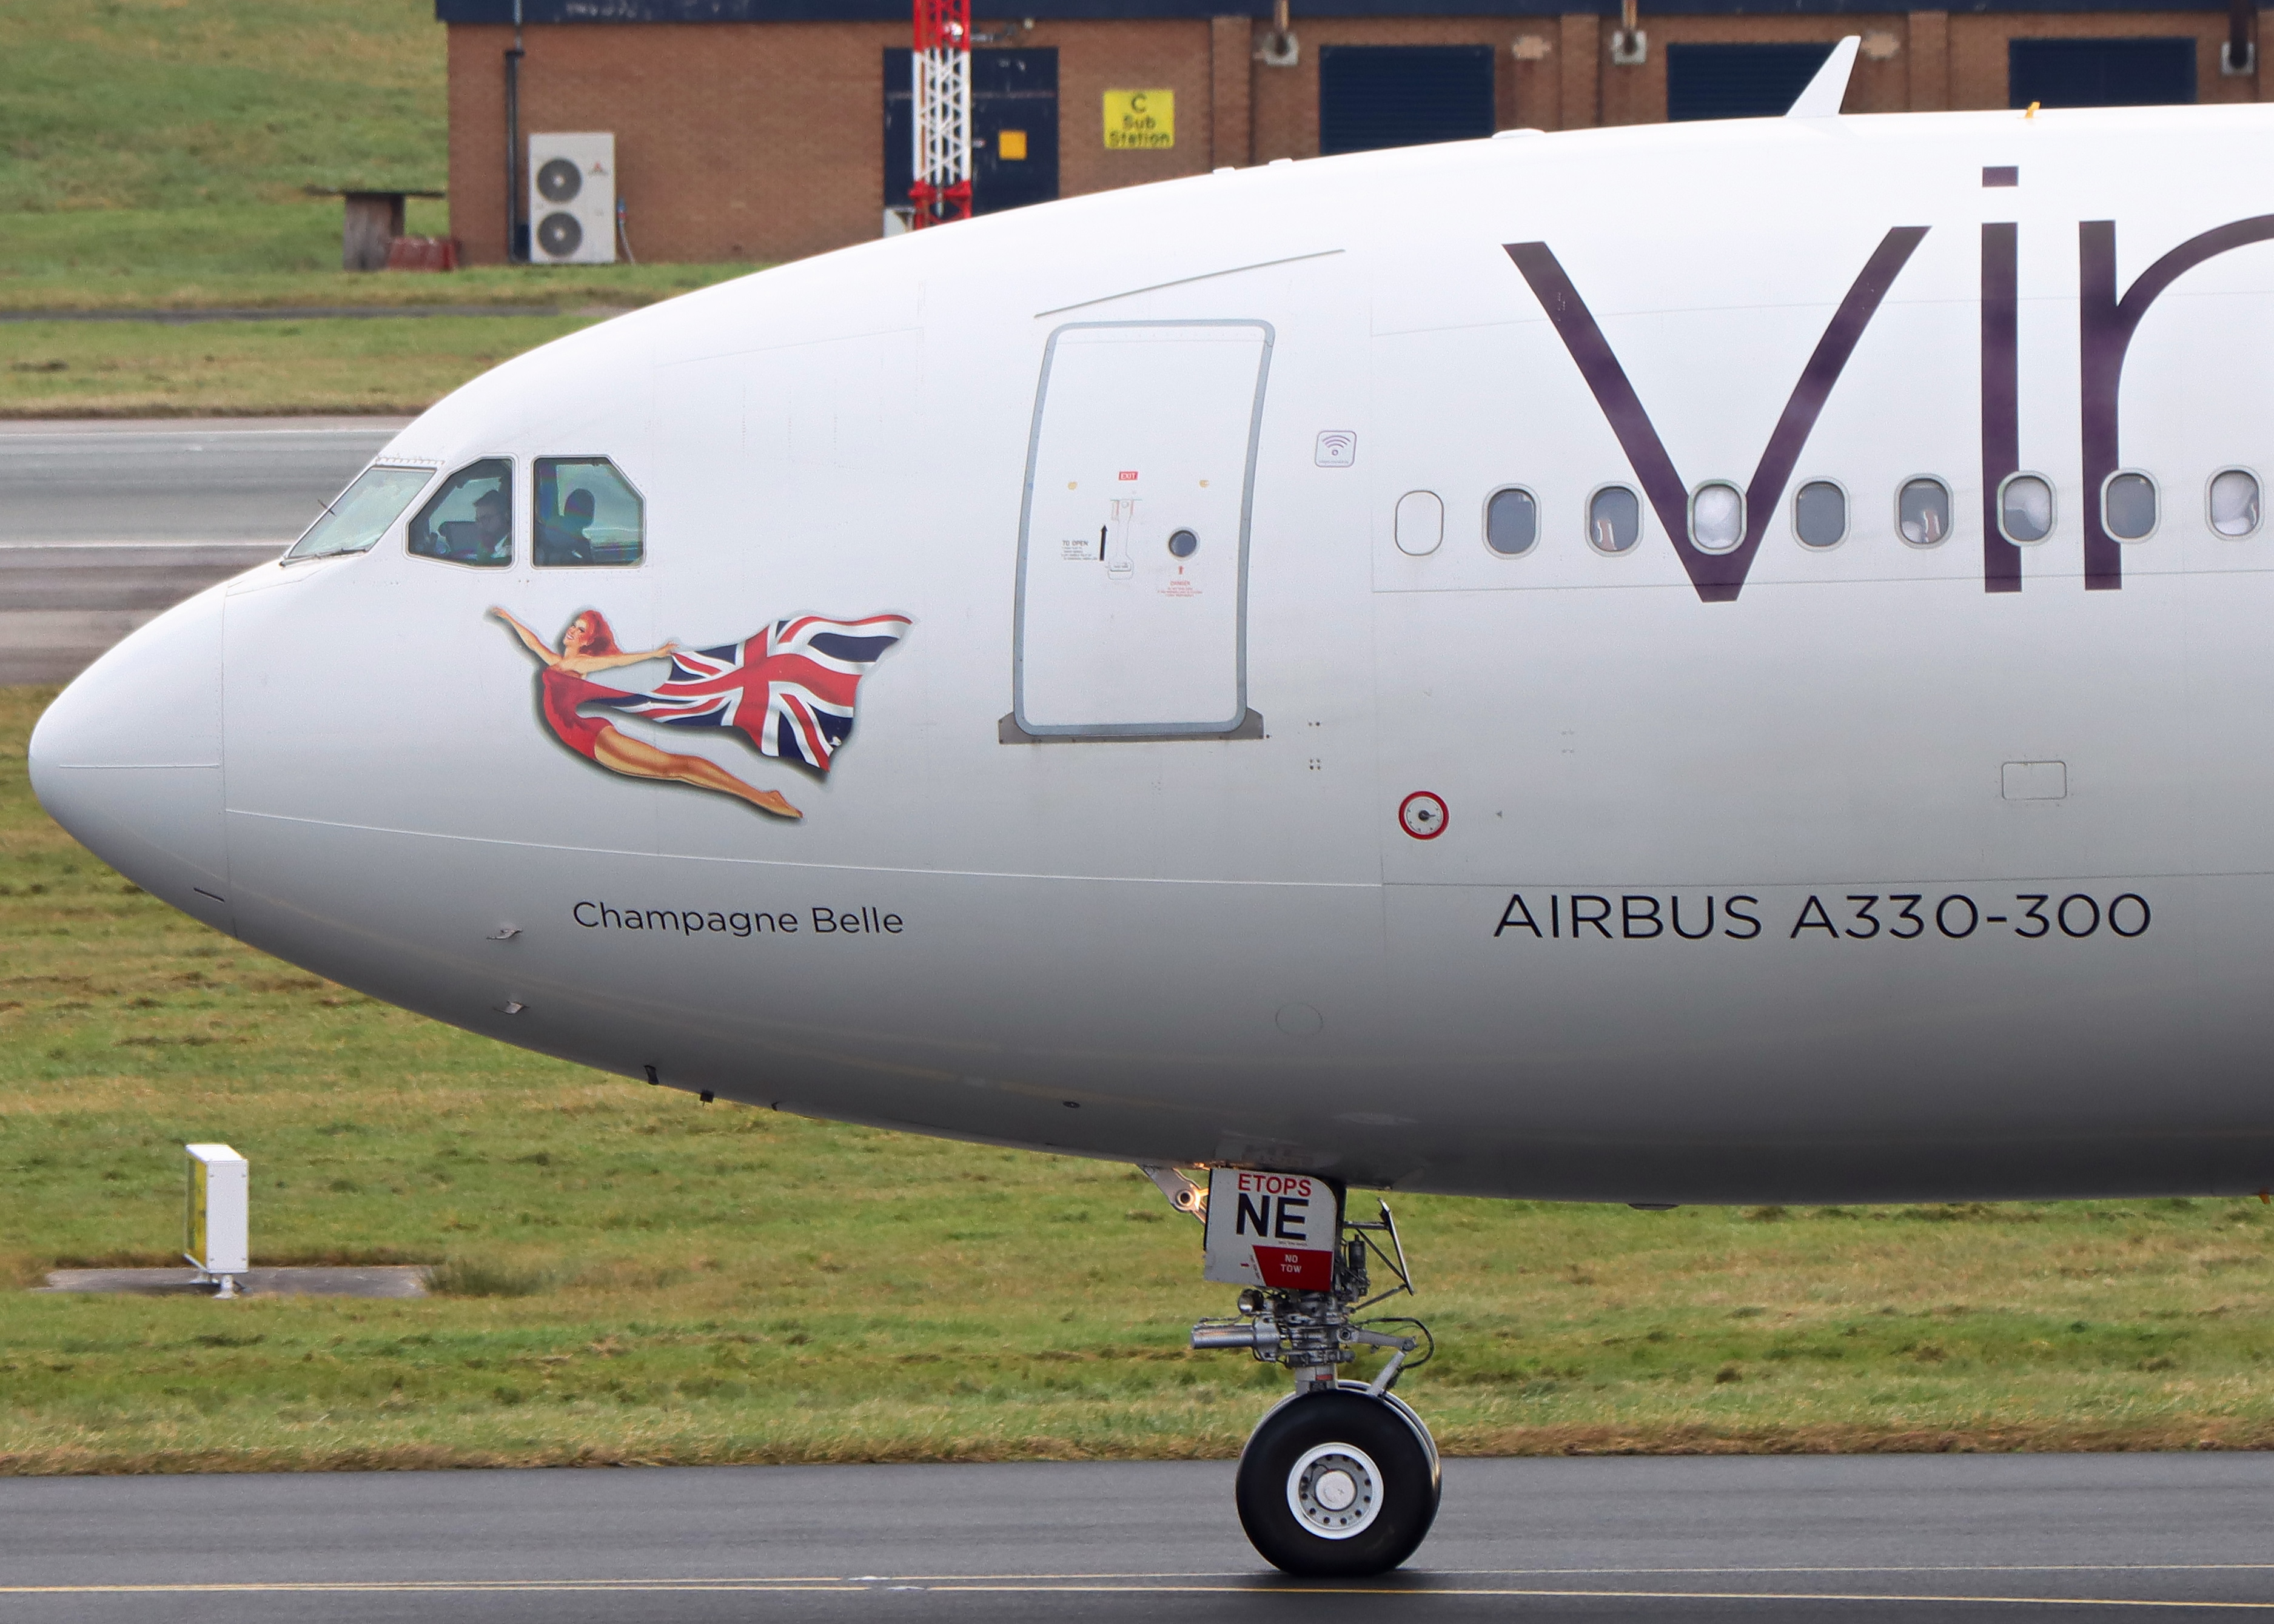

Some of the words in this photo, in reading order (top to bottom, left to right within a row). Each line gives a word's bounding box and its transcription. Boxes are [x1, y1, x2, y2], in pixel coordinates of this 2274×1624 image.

[1131, 93, 1147, 113] C
[1123, 114, 1156, 129] Sub
[1110, 130, 1170, 146] Station
[573, 902, 798, 937] Champagne
[812, 907, 904, 933] Belle
[1493, 894, 1762, 940] AIRBUS
[1789, 893, 2151, 940] A330-300
[1238, 1173, 1312, 1197] ETOPS
[1236, 1192, 1309, 1241] NE
[1280, 1264, 1302, 1273] TOW
[1284, 1254, 1298, 1263] NO
